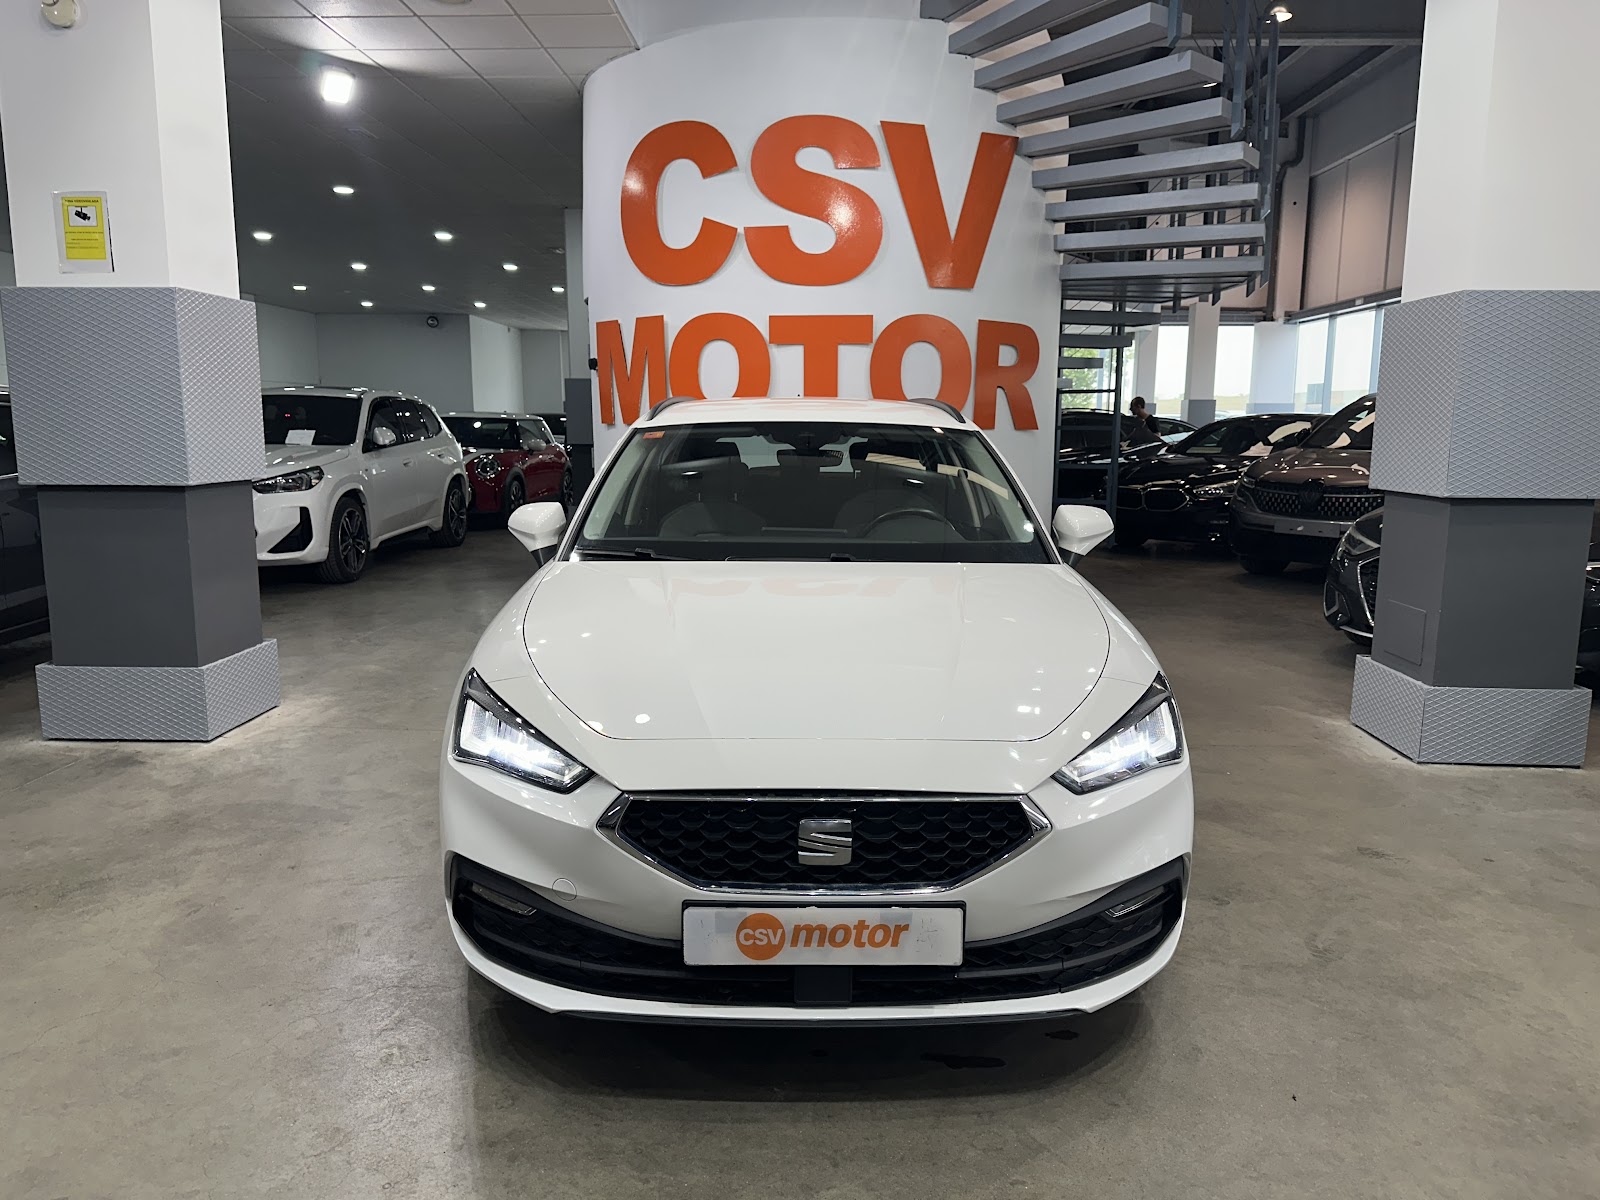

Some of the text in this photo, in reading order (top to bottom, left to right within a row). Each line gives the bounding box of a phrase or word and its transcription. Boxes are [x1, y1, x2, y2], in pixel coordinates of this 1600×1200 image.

[621, 114, 1019, 289] CSV
[596, 312, 1040, 430] MOTOR
[739, 919, 910, 948] CSV motor
